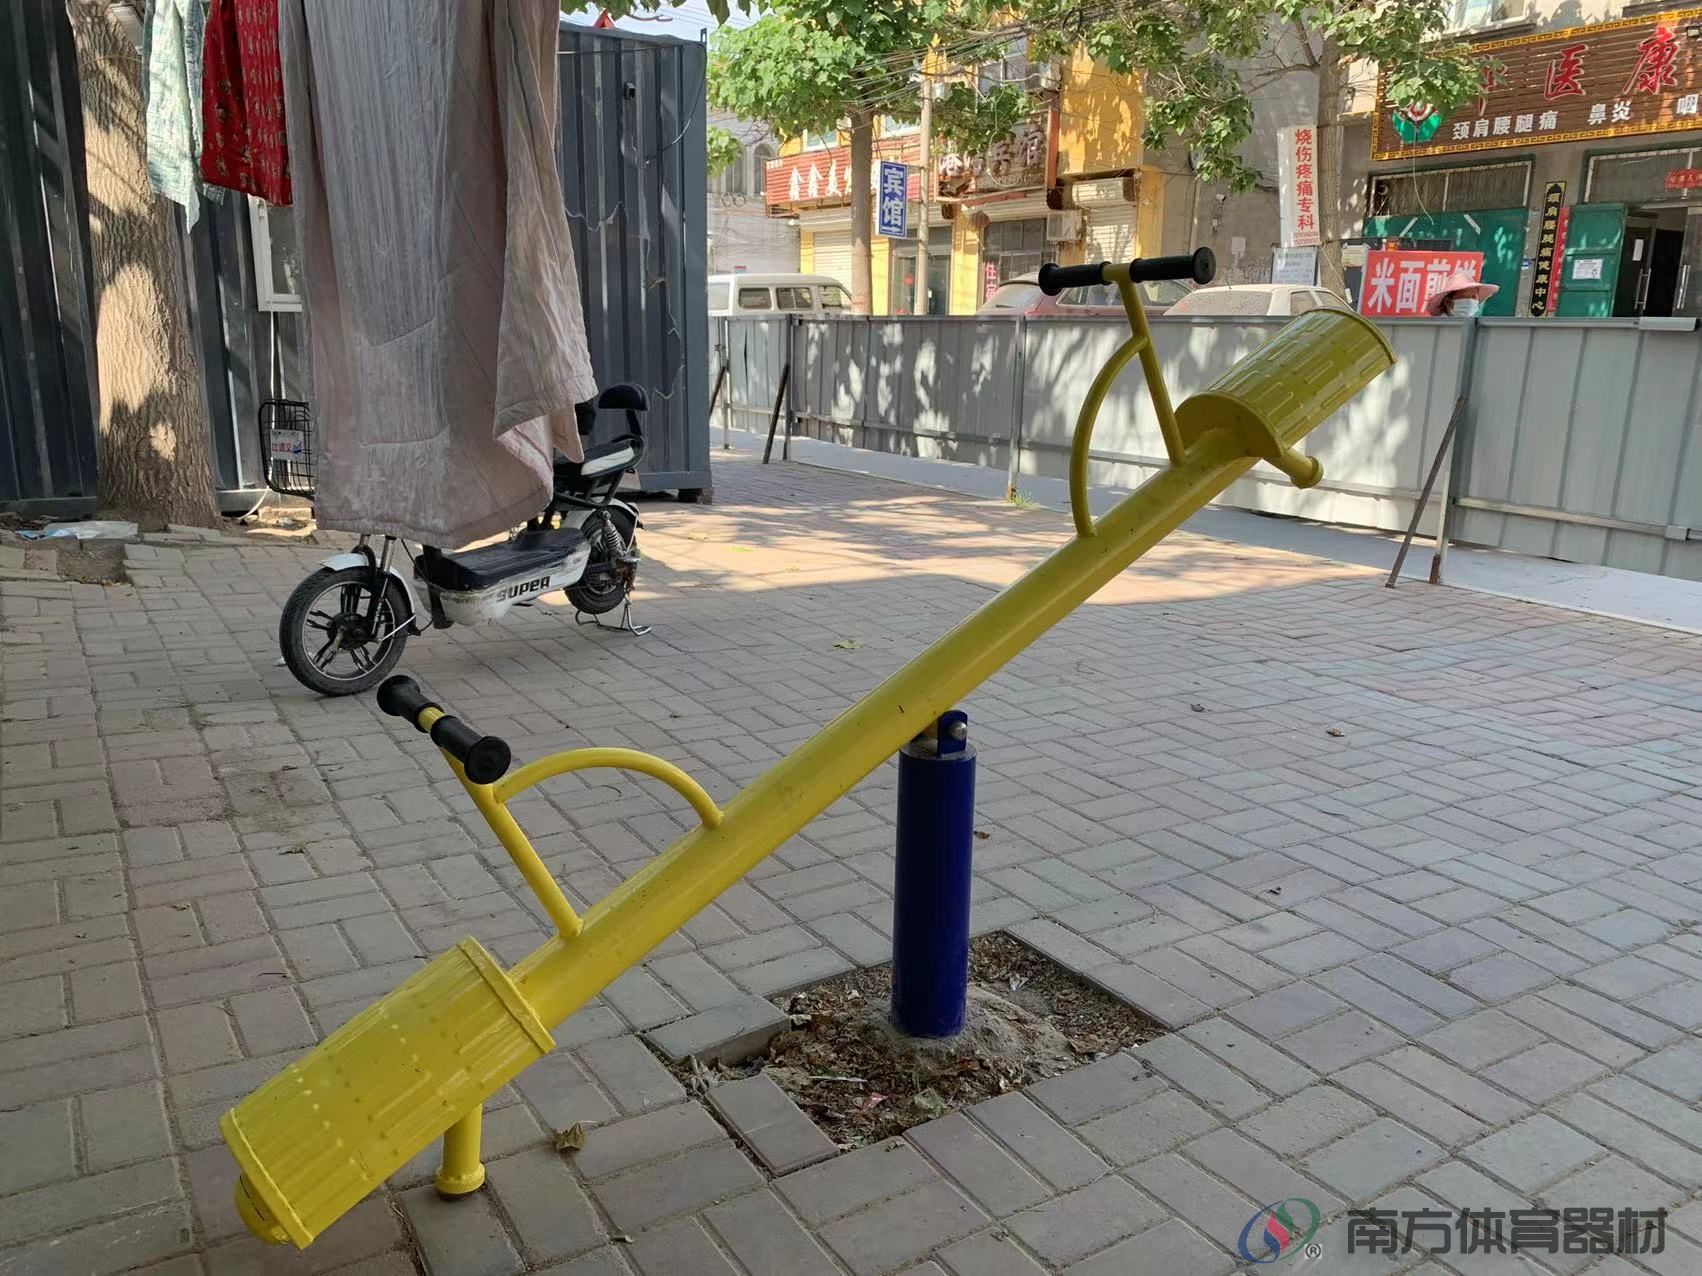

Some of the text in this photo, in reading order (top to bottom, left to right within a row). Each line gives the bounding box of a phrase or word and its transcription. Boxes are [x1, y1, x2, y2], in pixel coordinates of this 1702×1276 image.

[1452, 109, 1558, 140] 颈肩腰腿痛
[1587, 99, 1632, 125] 鼻炎
[882, 167, 904, 227] 宾馆
[1295, 128, 1315, 231] 烧伤疼痛专科
[496, 575, 551, 601] SUPER
